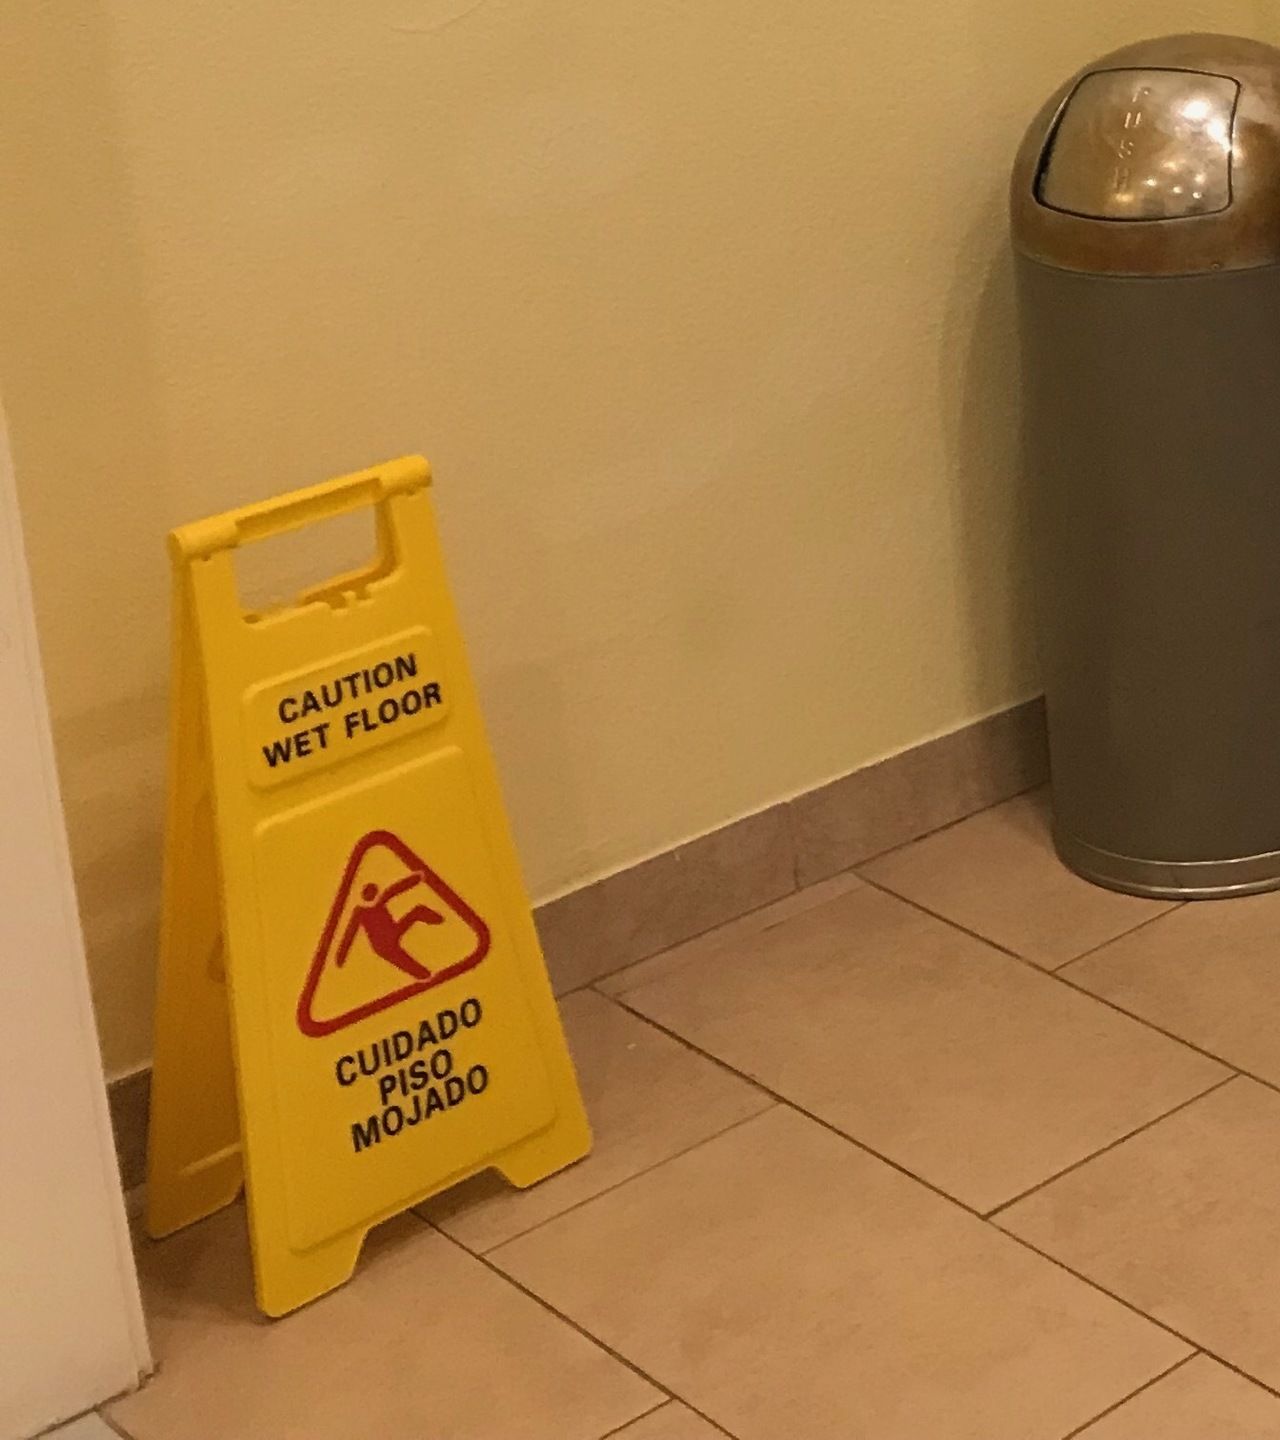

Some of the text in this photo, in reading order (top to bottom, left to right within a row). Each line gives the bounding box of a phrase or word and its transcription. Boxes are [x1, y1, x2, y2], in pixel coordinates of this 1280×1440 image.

[263, 682, 442, 768] WET FLOOR
[277, 653, 418, 724] CAUTION
[333, 997, 483, 1088] CUIDADO
[378, 1047, 455, 1106] PISO
[351, 1062, 489, 1152] MOJADO
